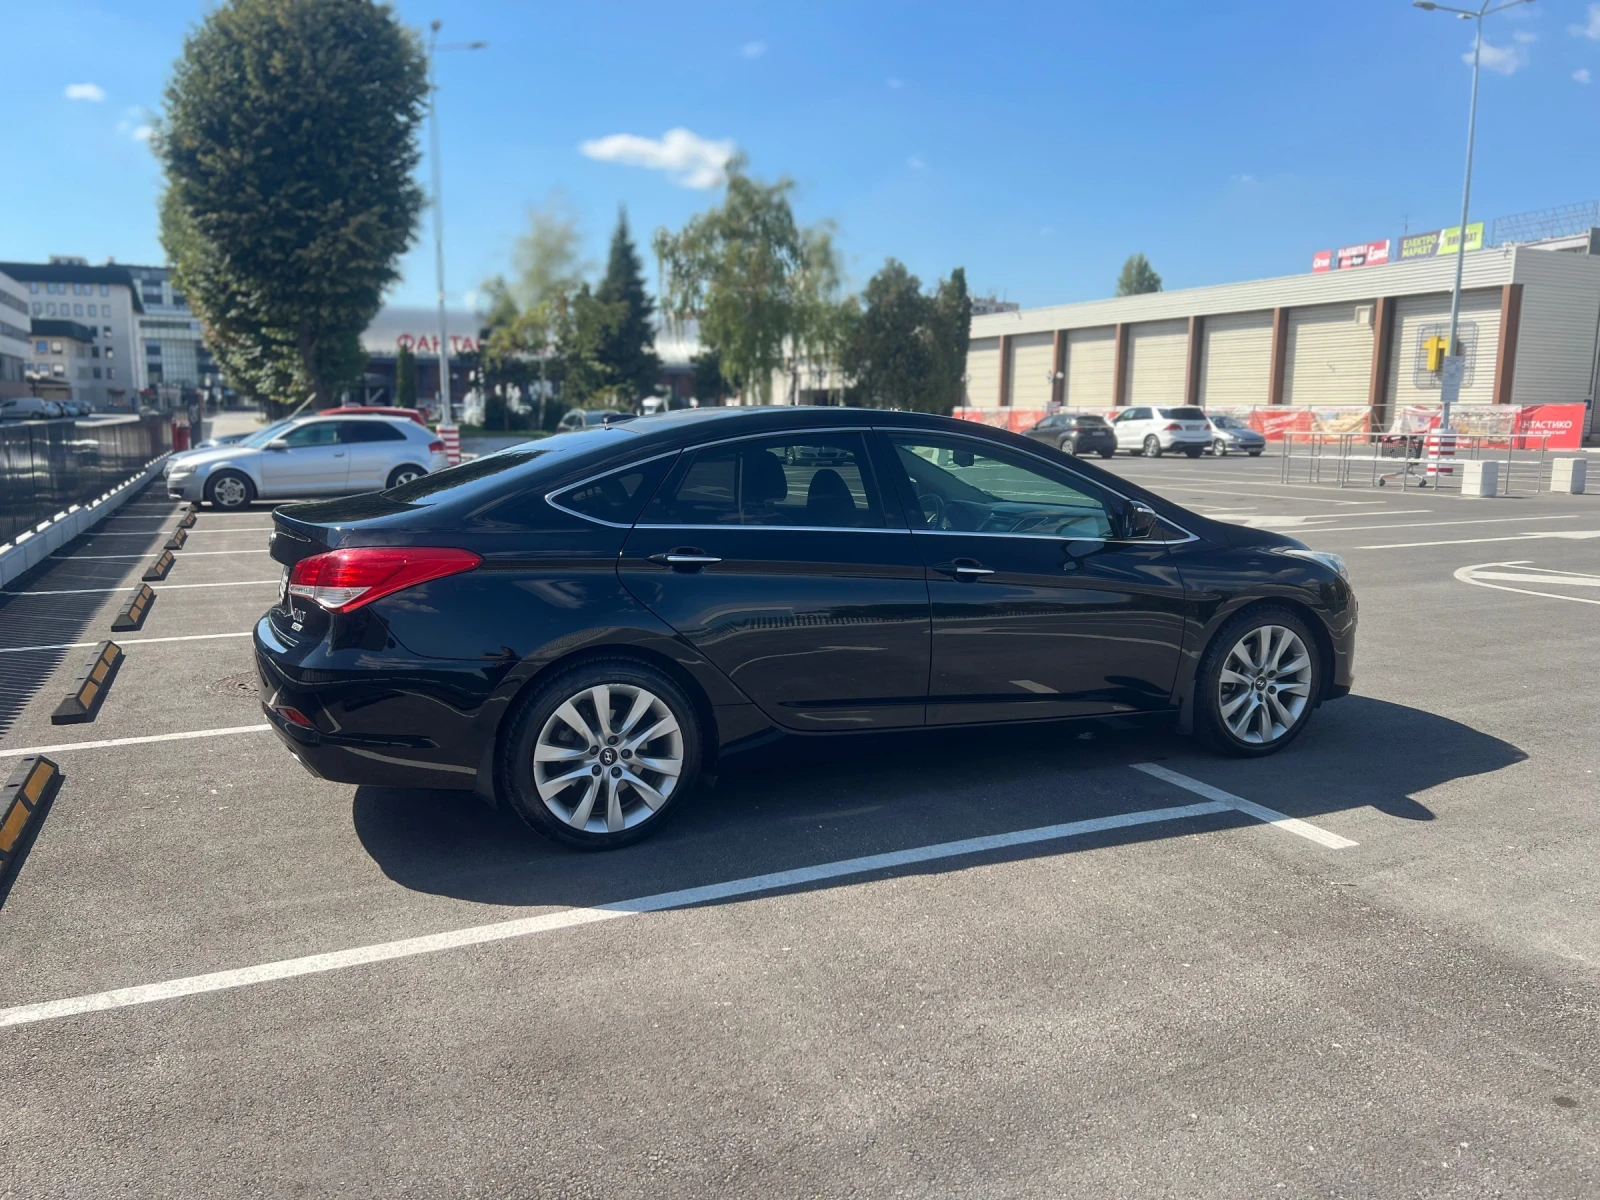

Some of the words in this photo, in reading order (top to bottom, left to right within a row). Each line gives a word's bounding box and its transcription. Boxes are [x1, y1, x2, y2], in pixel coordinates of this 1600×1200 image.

[1403, 235, 1436, 248] ЕЛЕКТРО
[1402, 244, 1432, 258] МАРКЕТ
[1521, 420, 1572, 429] НТАСТИКО
